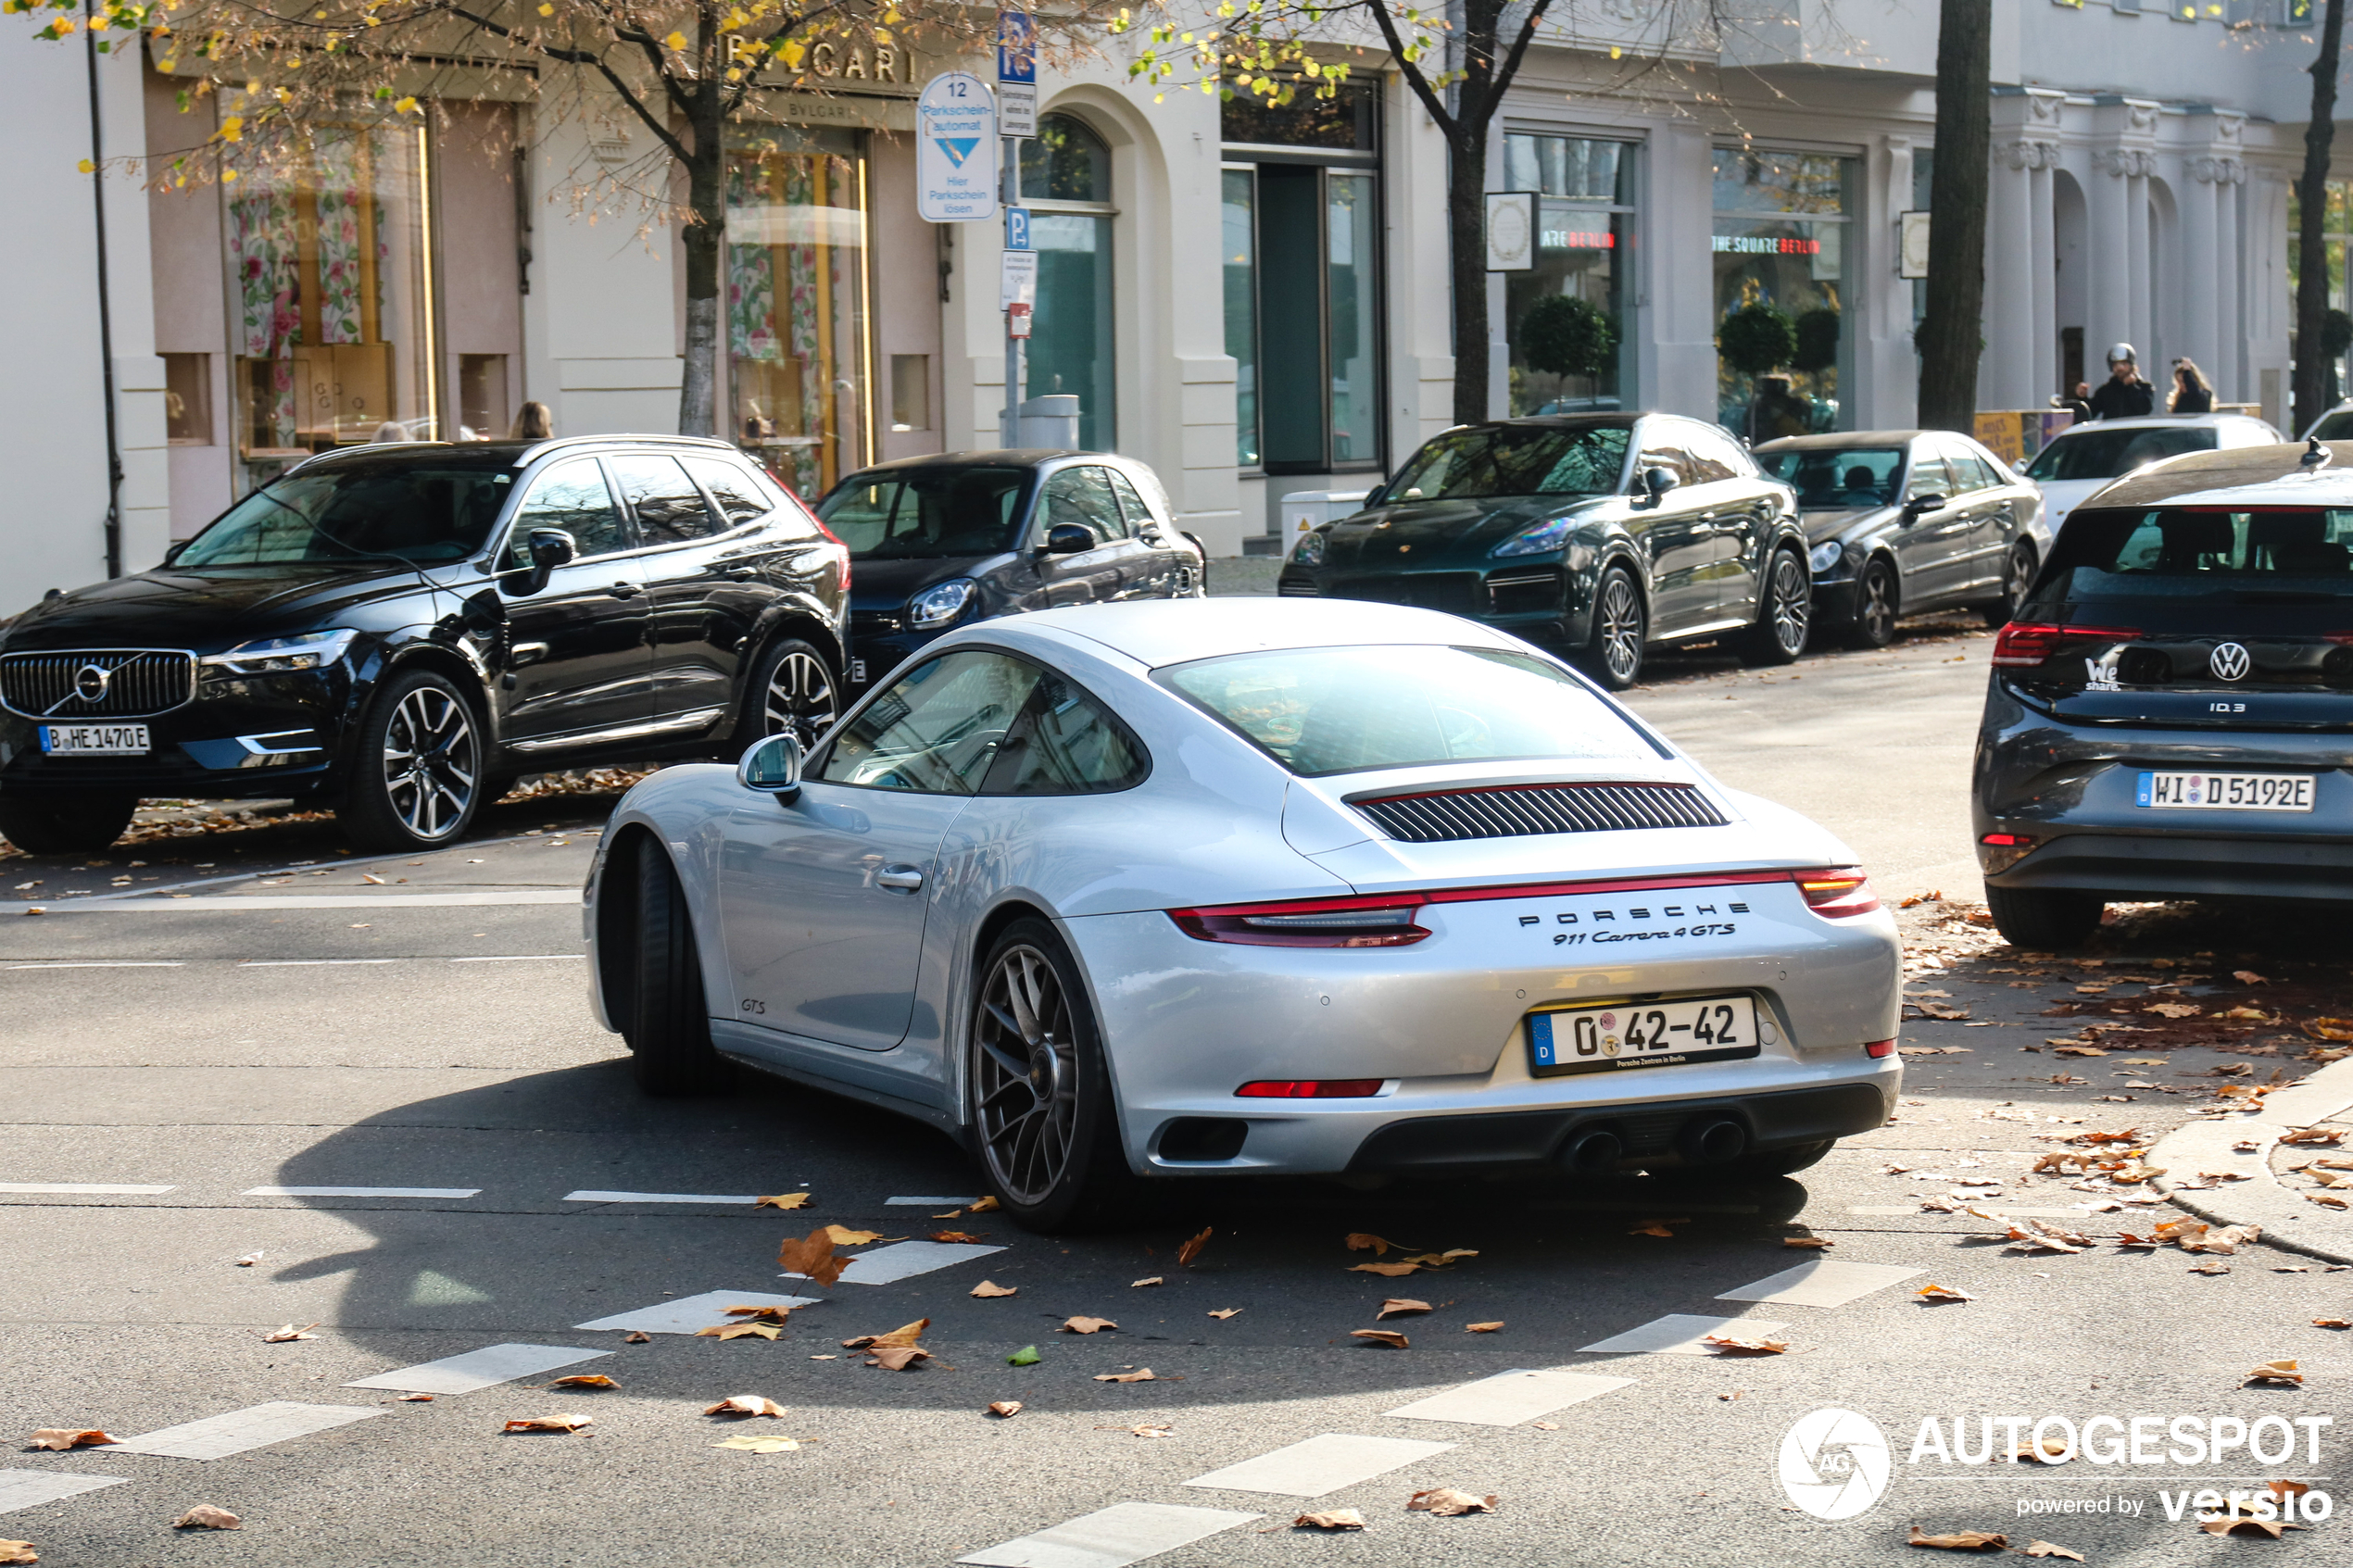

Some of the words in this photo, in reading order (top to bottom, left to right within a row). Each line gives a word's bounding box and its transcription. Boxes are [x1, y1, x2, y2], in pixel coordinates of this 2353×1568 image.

[727, 34, 916, 83] BLGARI
[948, 82, 967, 97] 12
[923, 104, 993, 117] Parkschein-
[933, 120, 981, 132] automat
[947, 176, 969, 187] Hier
[929, 190, 988, 201] Parkschein
[943, 204, 973, 214] lösen
[1711, 235, 1731, 252] THE
[1734, 236, 1779, 255] SQUARE
[1780, 237, 1821, 255] BERLIN
[2085, 658, 2119, 681] We
[49, 729, 61, 748] B
[69, 728, 92, 748] HE
[2207, 777, 2223, 805] D
[2229, 778, 2310, 807] 5192E
[1517, 902, 1751, 927] PORSCHE
[1553, 933, 1588, 946] 911
[1592, 930, 1671, 944] Carrera
[1673, 926, 1687, 937] 4
[1690, 923, 1736, 937] GTS
[741, 998, 766, 1015] GTS
[1539, 1047, 1550, 1059] D
[1624, 1004, 1738, 1051] 42-42
[1617, 1059, 1641, 1068] Porsche
[1641, 1057, 1663, 1066] Zentren
[1669, 1054, 1686, 1063] Berlin
